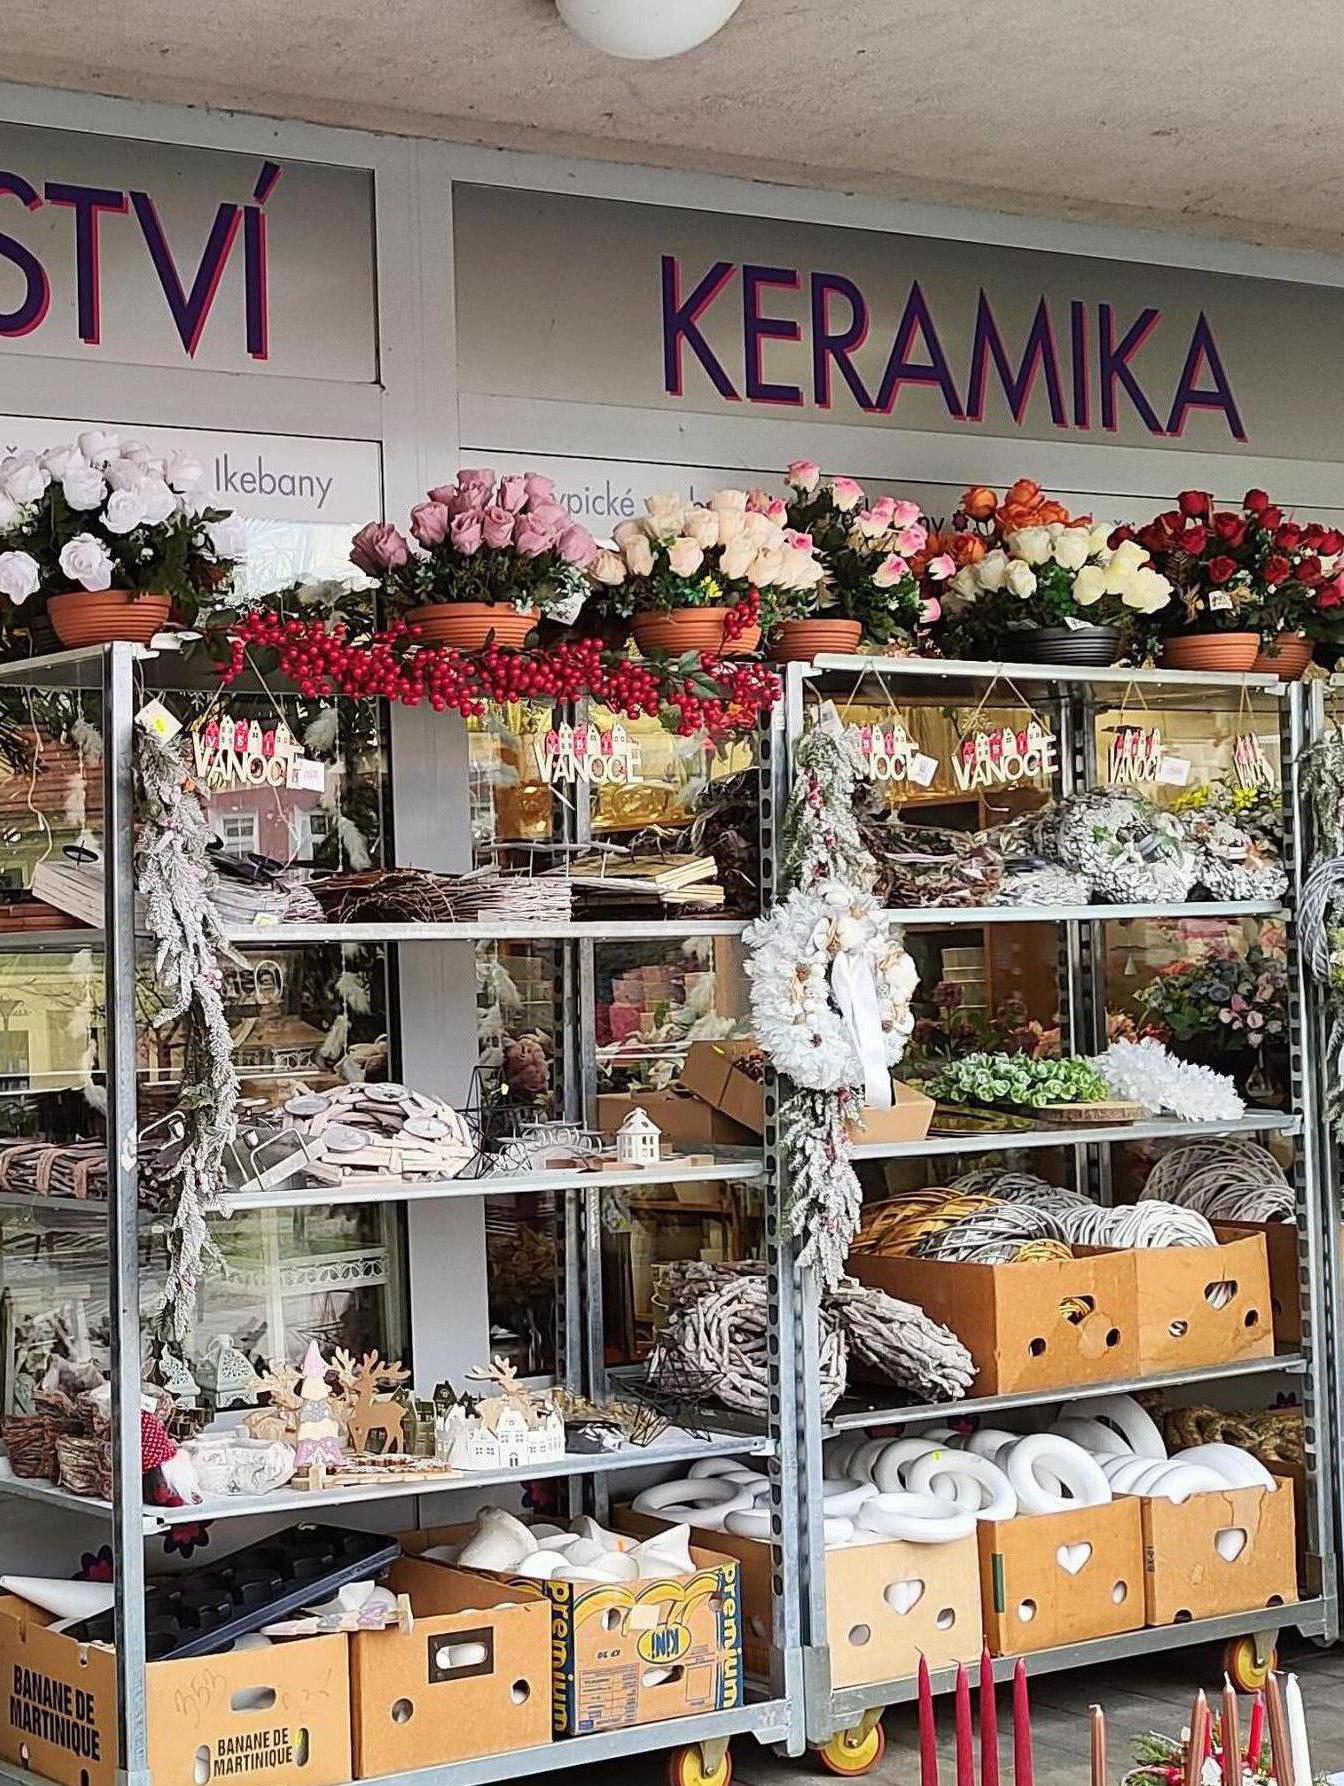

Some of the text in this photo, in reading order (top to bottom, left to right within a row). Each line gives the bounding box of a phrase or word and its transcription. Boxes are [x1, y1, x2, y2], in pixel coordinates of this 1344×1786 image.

[660, 254, 1249, 442] KERAMIKA
[214, 453, 334, 509] Ikebany
[13, 1664, 74, 1717] BANANE
[75, 1686, 95, 1725] DE
[9, 1695, 101, 1762] MARTINIQUE
[217, 1727, 290, 1756] BANANE DE
[213, 1745, 293, 1778] MARTINIQUE
